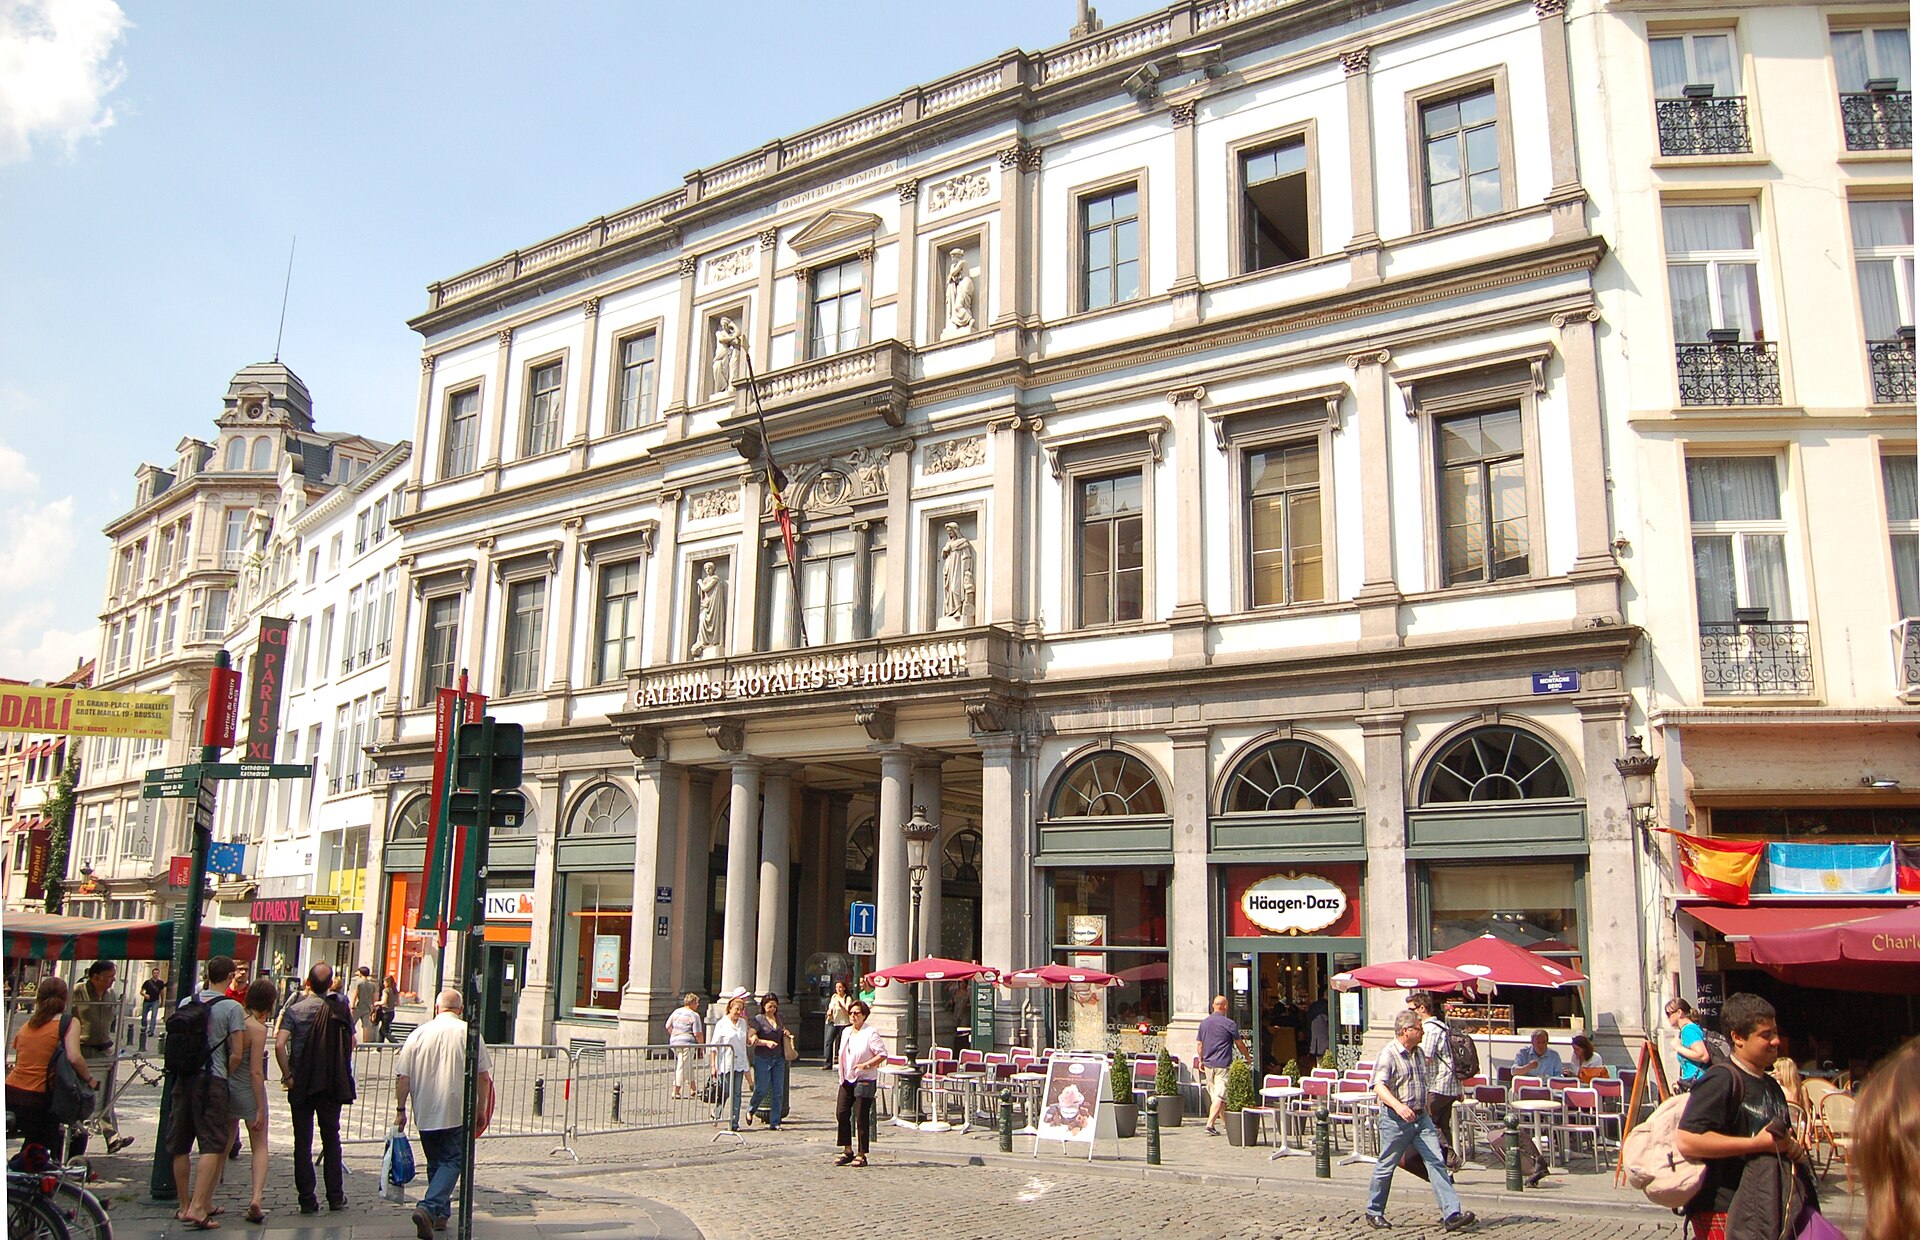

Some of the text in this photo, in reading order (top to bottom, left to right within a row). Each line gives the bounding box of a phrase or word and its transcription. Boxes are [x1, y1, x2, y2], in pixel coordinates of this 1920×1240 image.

[782, 163, 894, 209] OMNIBUS OMNIA
[249, 627, 287, 760] ICI PARIS XL
[634, 680, 723, 708] GALERIES
[735, 672, 823, 697] ROYALES
[863, 655, 957, 684] HUBERT
[1539, 676, 1570, 684] MONTAGNE
[1, 692, 75, 731] DALÍ
[75, 708, 96, 716] GROTE
[133, 711, 162, 719] BRUSSEL
[134, 703, 169, 711] BRUXELLES
[223, 712, 231, 739] Quartier
[227, 678, 235, 699] Centre
[251, 901, 263, 922] ICI
[264, 901, 288, 922] PARIS
[288, 900, 300, 922] XL
[488, 897, 516, 914] ING
